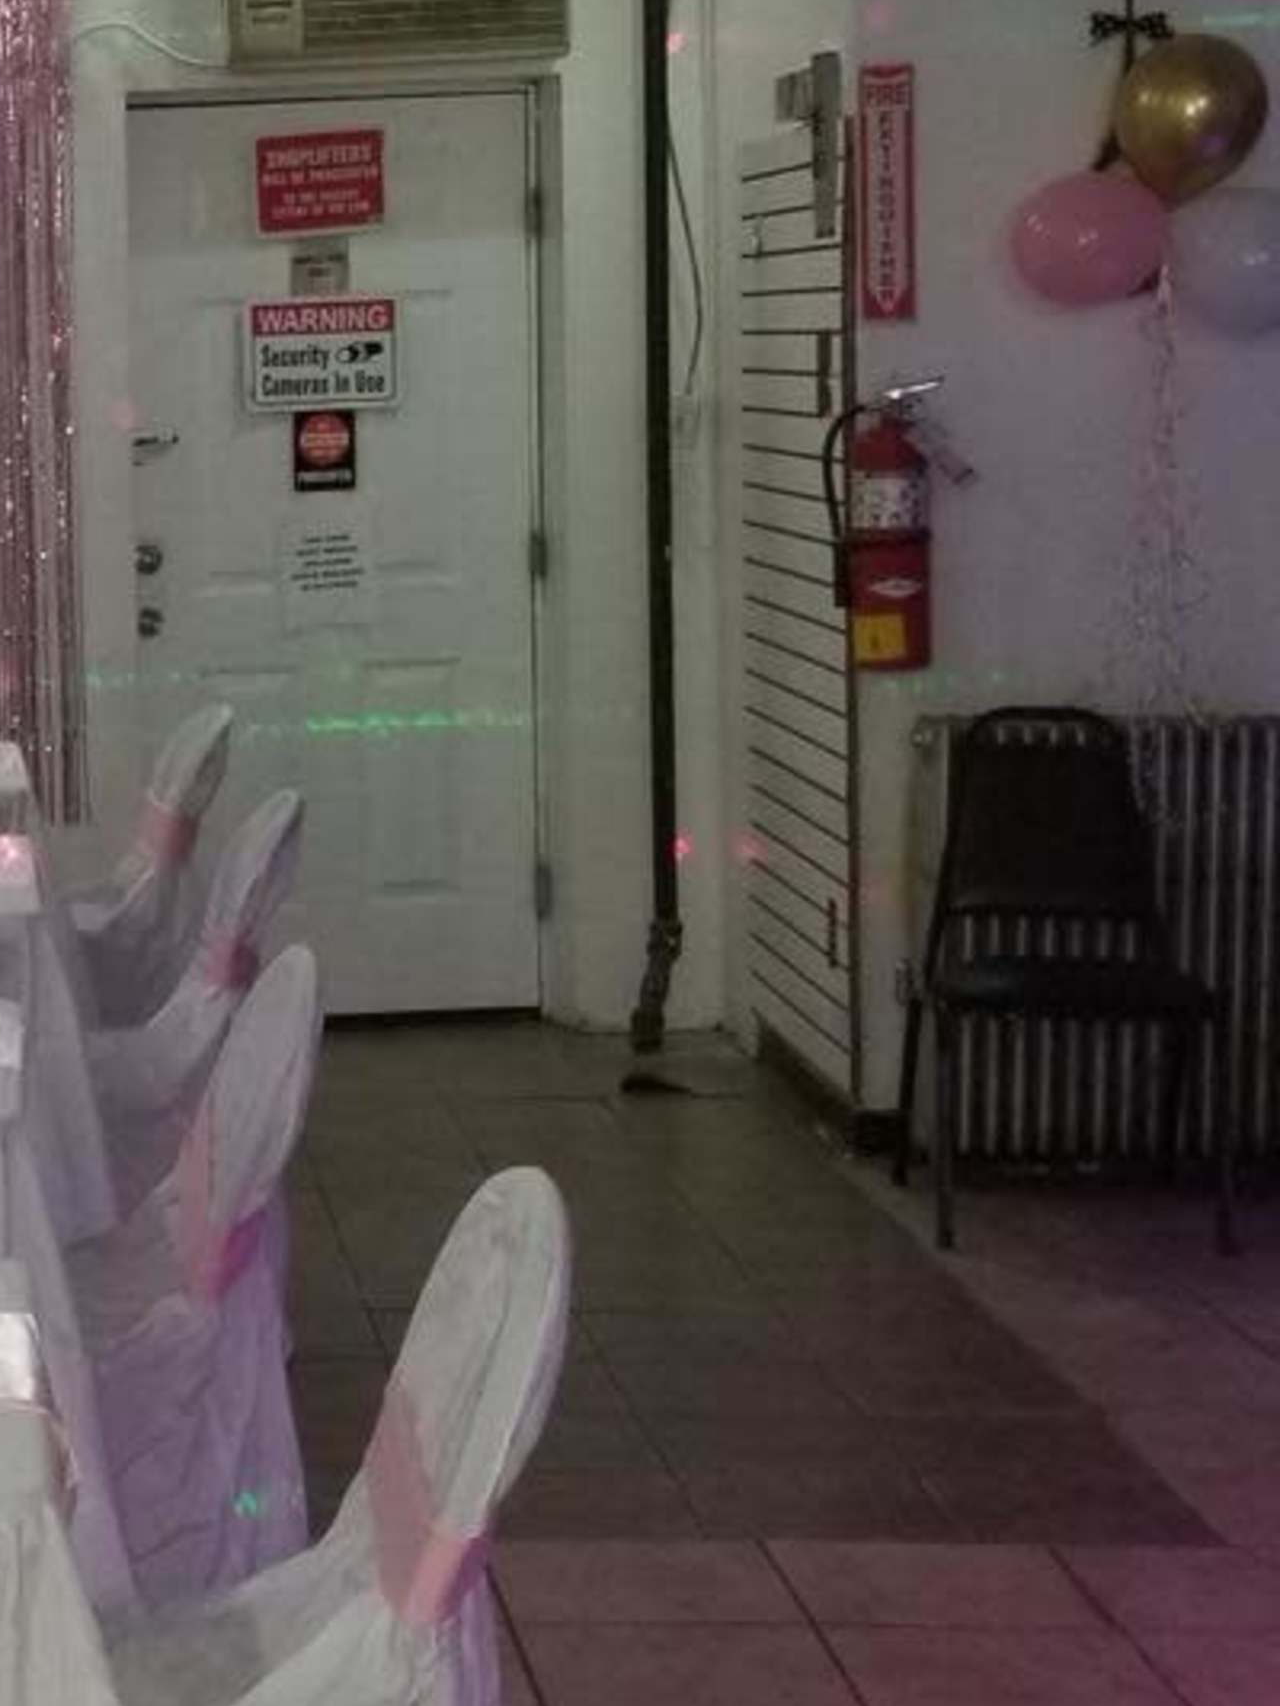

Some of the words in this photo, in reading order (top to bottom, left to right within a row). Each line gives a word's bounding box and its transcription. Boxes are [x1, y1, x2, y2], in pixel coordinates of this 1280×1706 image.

[257, 305, 389, 333] WARNING
[260, 344, 330, 371] Security
[262, 373, 329, 397] Cameras
[355, 369, 386, 394] Use
